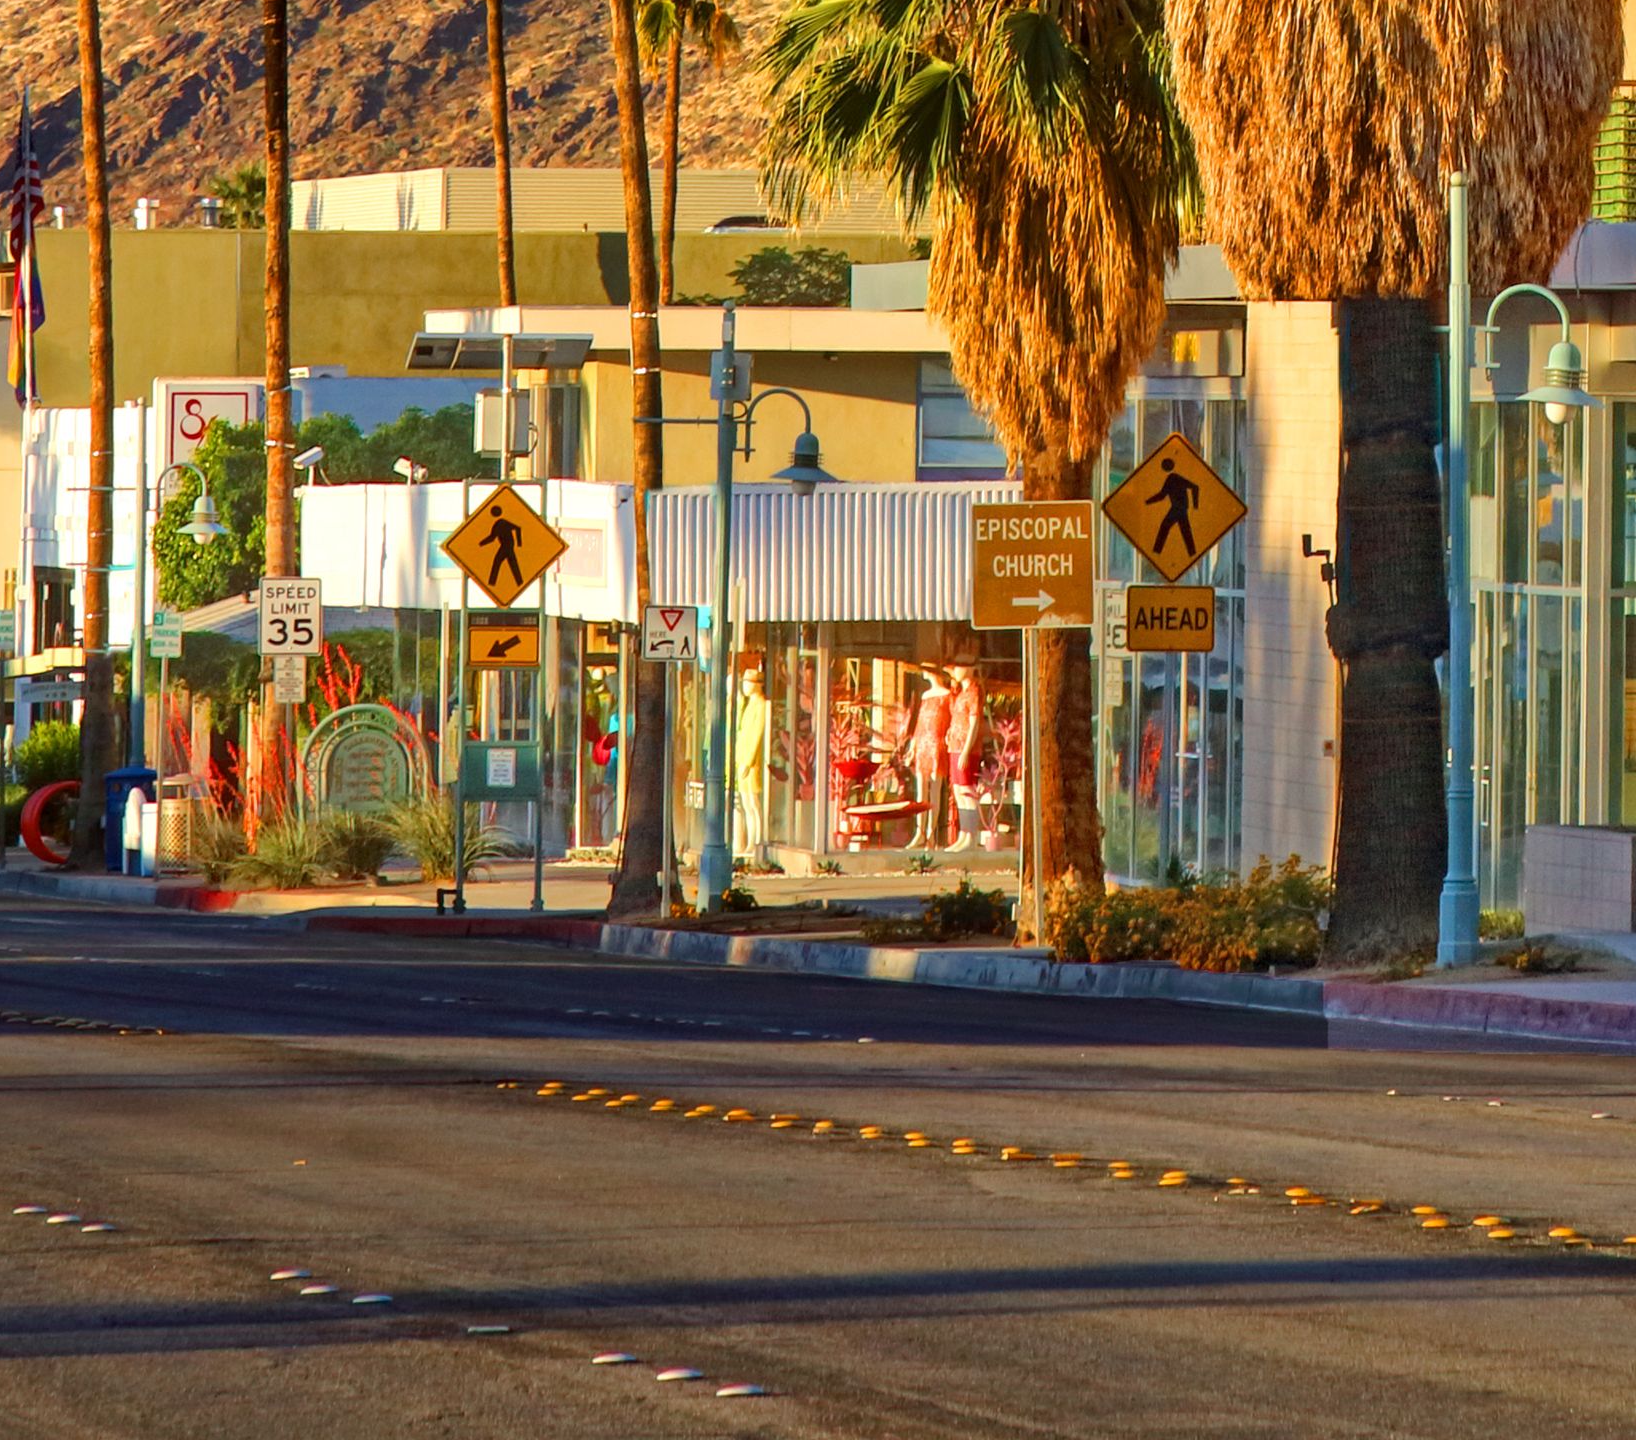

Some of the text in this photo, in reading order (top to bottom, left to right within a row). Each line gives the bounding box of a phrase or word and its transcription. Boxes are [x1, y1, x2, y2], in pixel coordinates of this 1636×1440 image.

[975, 516, 1089, 541] EPISCOPAL
[992, 553, 1074, 577] CHURCH
[265, 586, 317, 599] SPEED
[270, 603, 310, 615] LIMIT
[1133, 606, 1209, 631] AHEAD
[267, 618, 314, 646] 35
